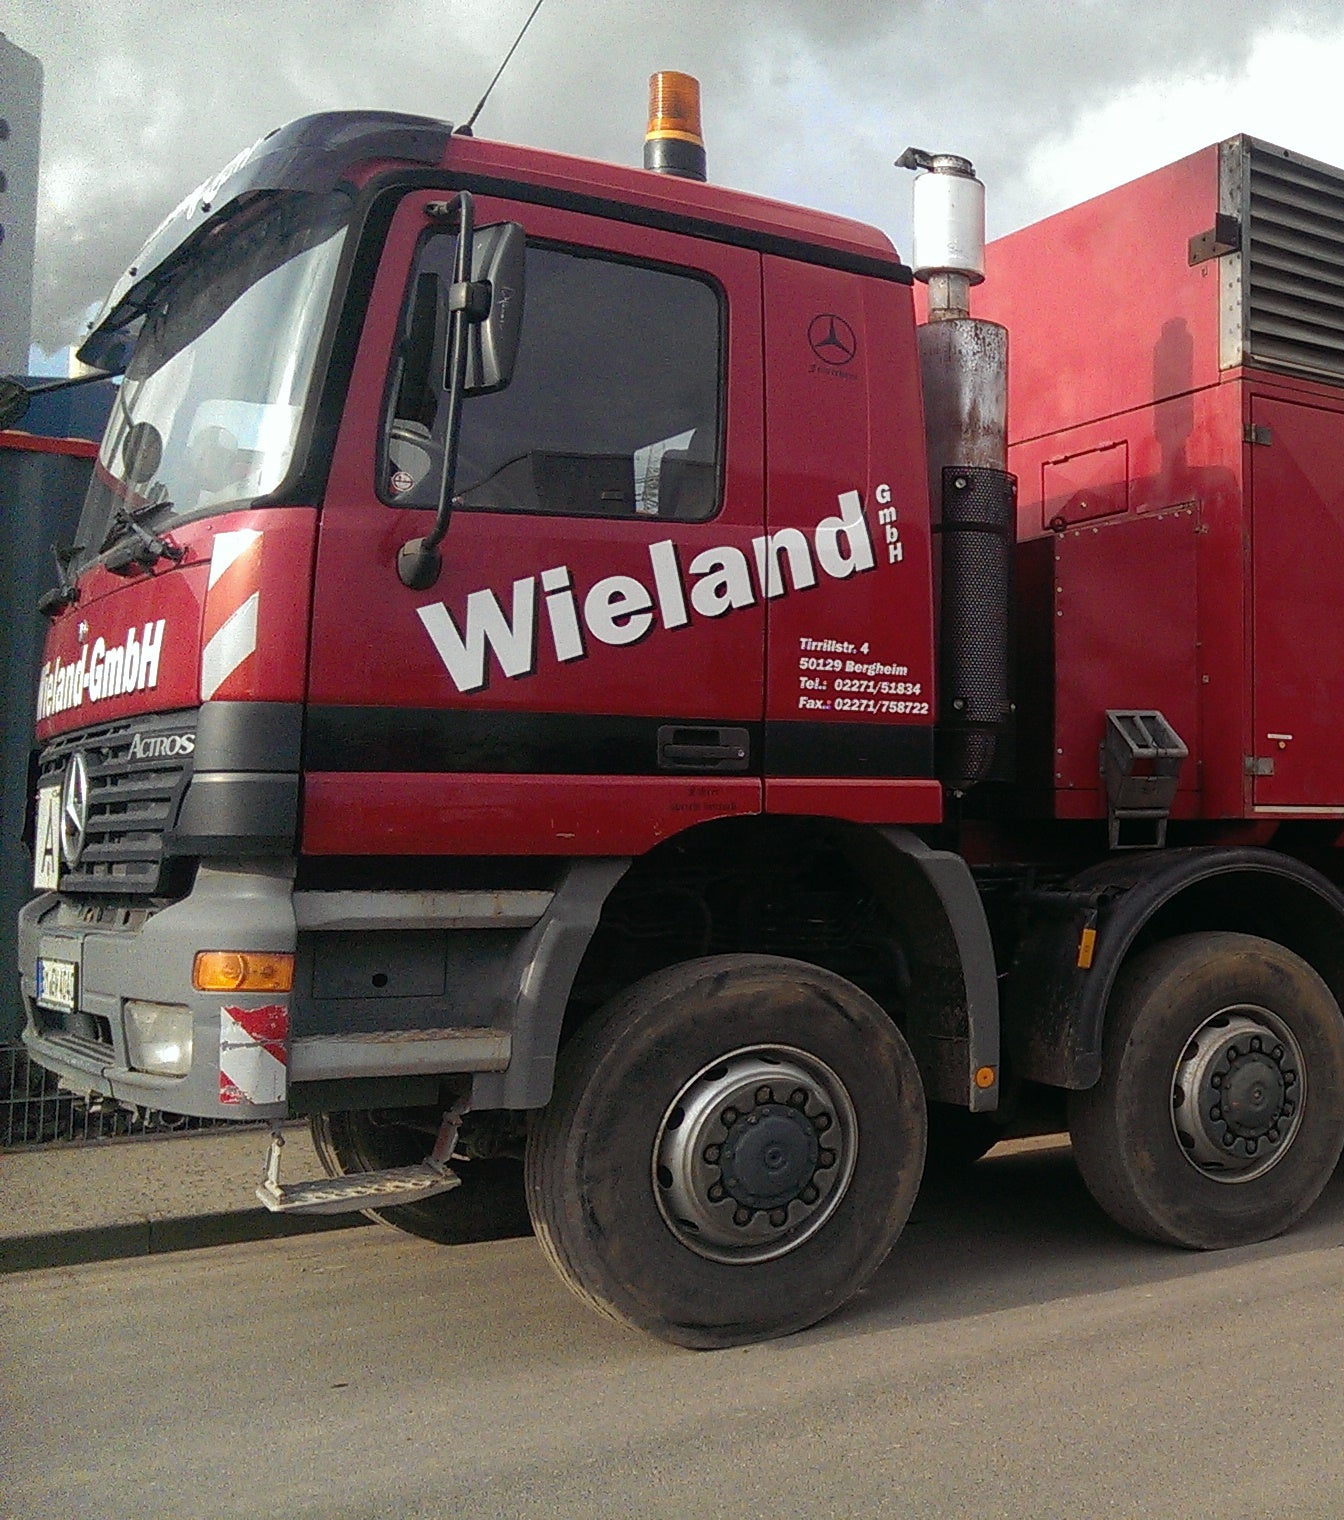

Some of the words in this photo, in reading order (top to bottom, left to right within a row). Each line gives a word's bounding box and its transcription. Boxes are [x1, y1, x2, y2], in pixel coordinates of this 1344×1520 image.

[875, 483, 903, 564] GmbH
[416, 489, 875, 693] Wieland
[860, 642, 870, 654] 4
[799, 657, 842, 672] 50129
[845, 660, 908, 676] Bergheim
[834, 678, 921, 695] 02271/51834
[834, 698, 929, 714] 02271/758722
